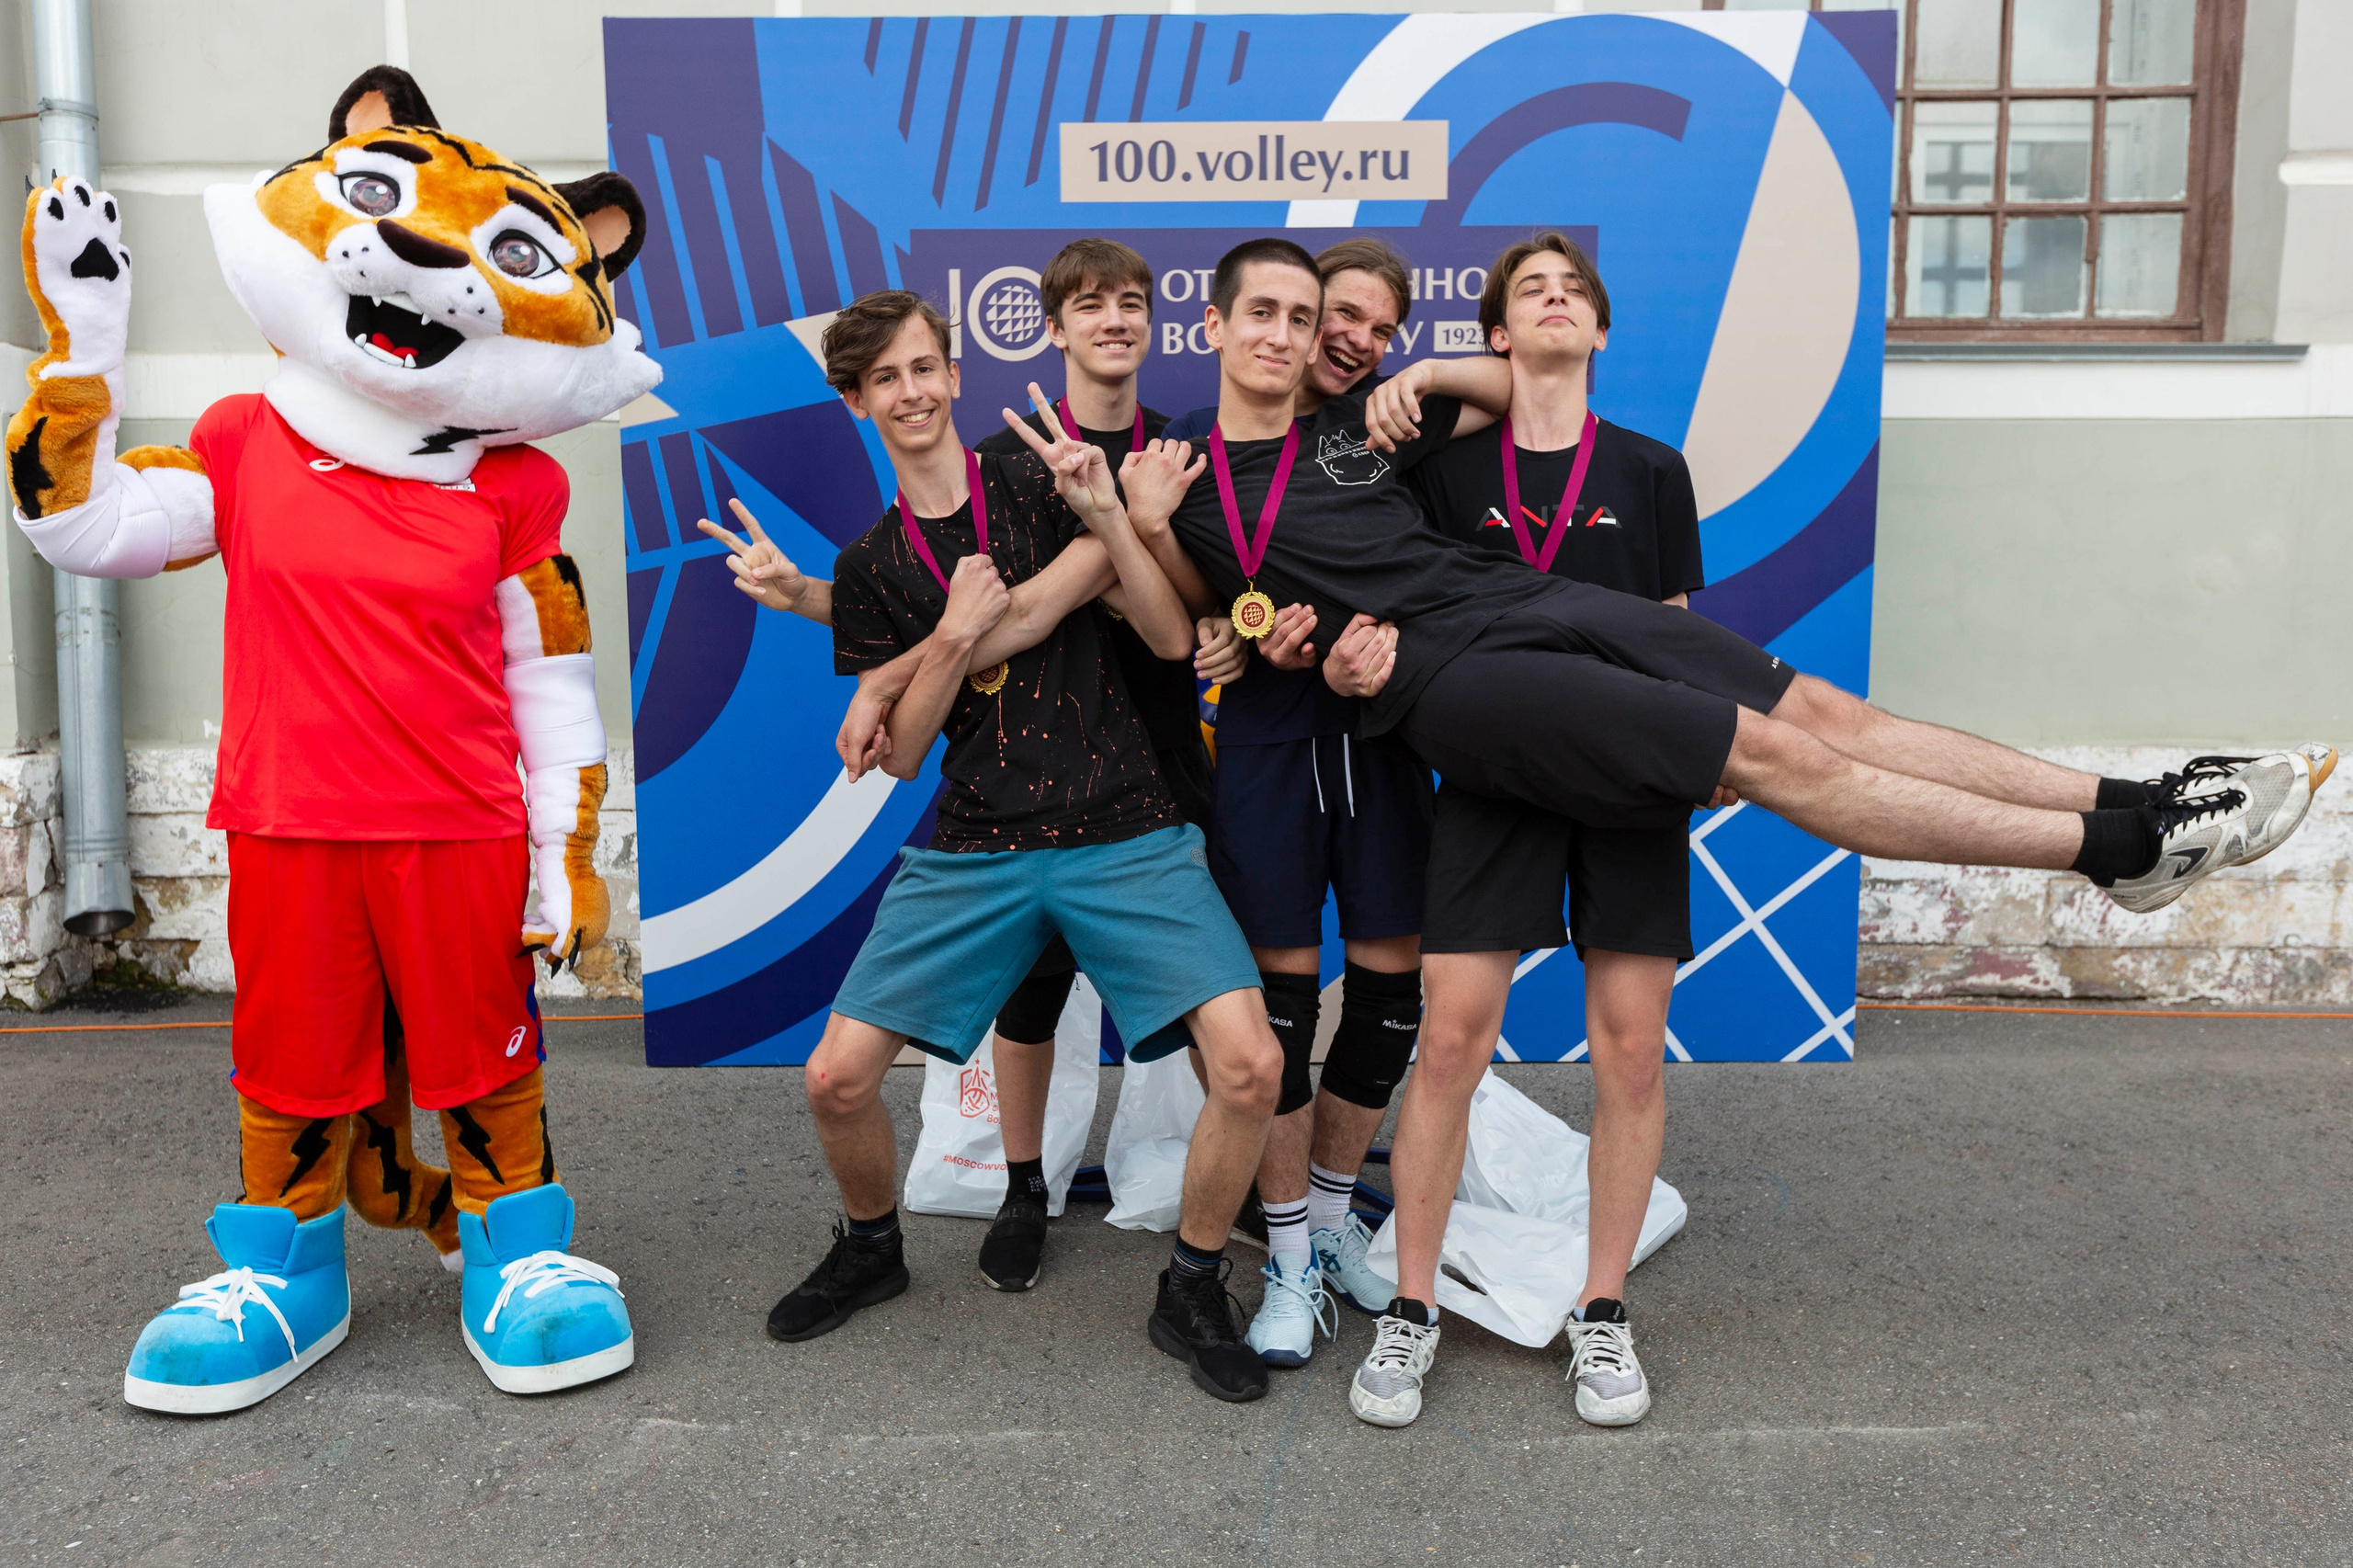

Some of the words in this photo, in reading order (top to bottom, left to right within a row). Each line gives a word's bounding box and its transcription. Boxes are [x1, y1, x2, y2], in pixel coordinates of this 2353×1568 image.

[1089, 134, 1410, 193] 100.volley.ru
[1267, 1011, 1293, 1028] KASA
[943, 1154, 1009, 1172] #MOSCOWVO
